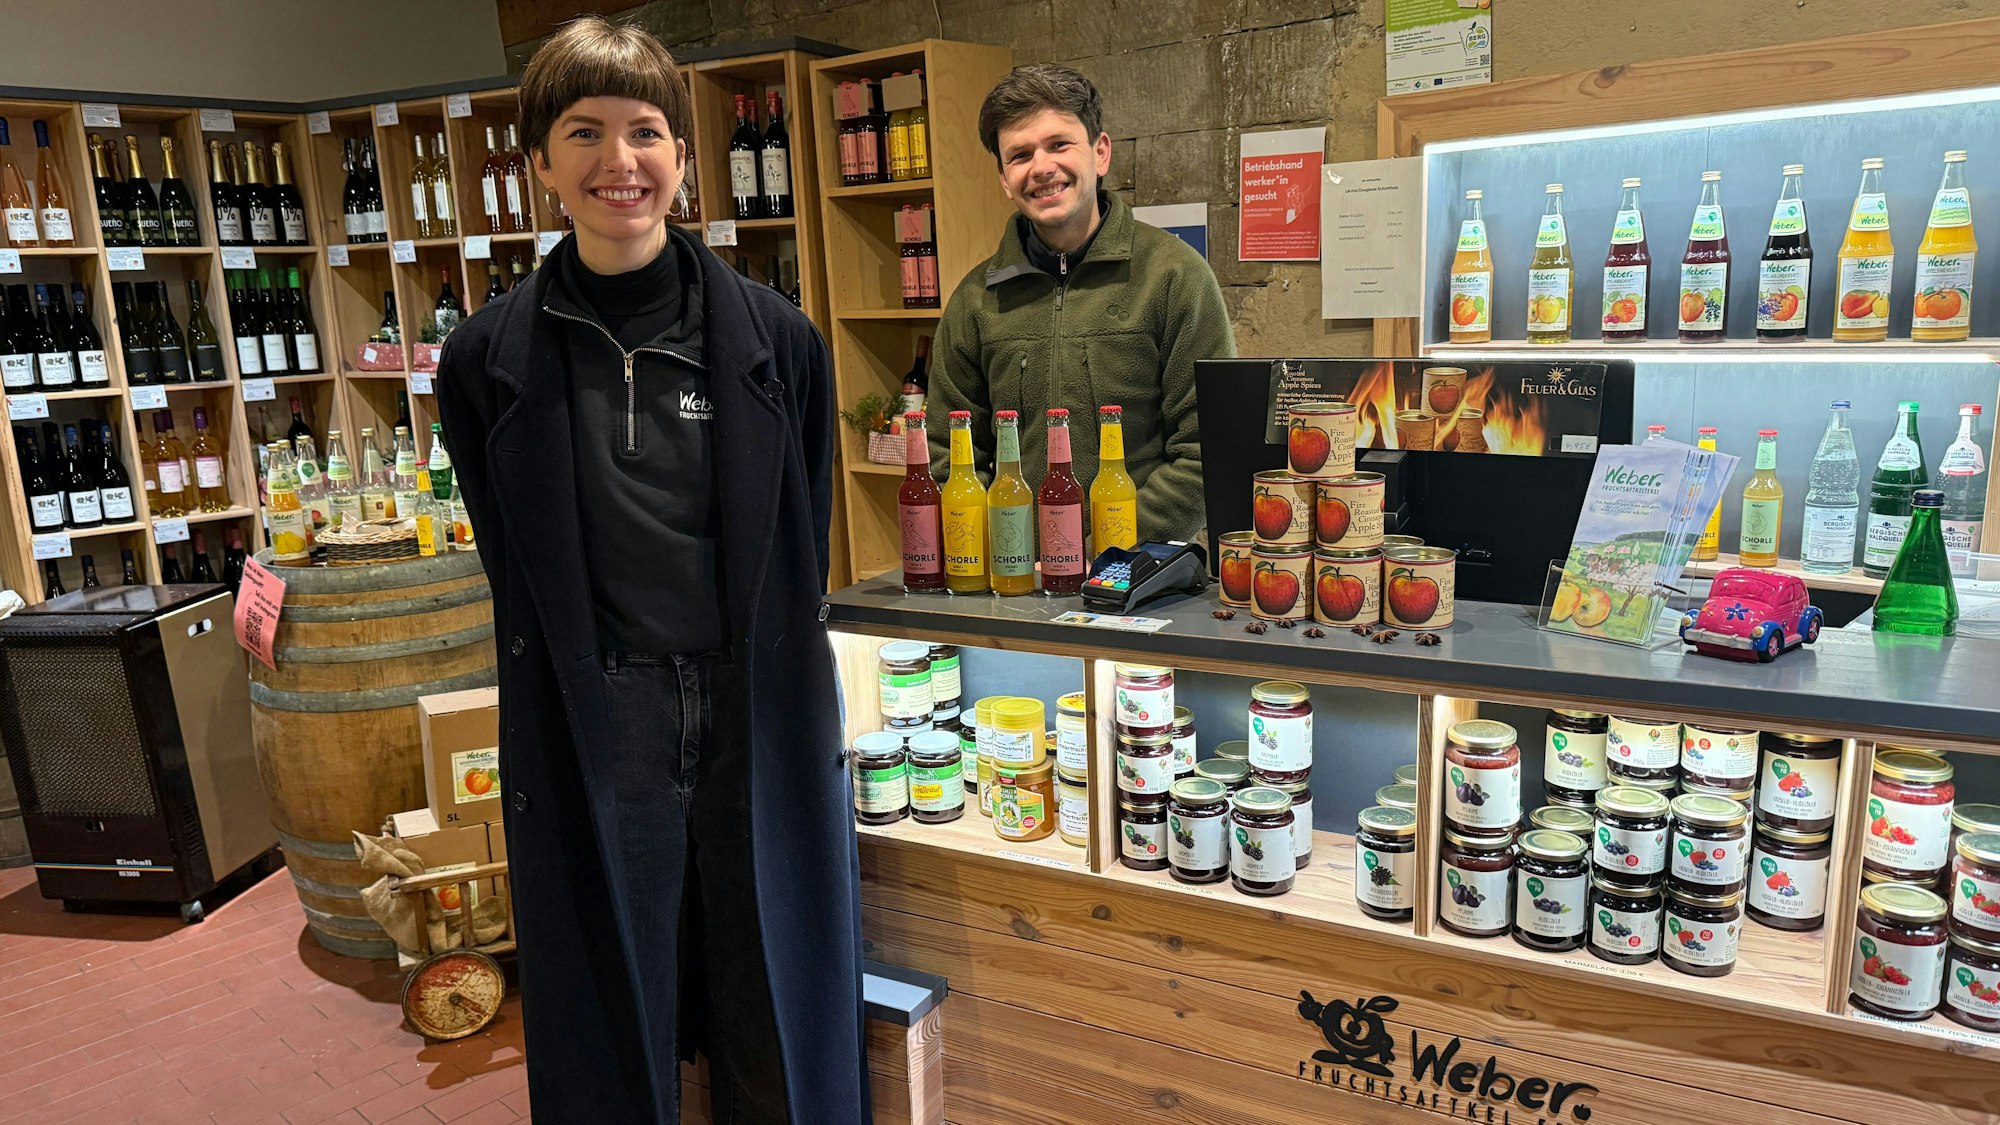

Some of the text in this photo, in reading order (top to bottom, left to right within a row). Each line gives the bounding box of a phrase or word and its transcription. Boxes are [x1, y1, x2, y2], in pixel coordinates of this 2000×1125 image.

[1245, 158, 1303, 172] Betriebshand
[1244, 190, 1277, 204] gesucht
[1278, 379, 1322, 390] Apple Spices
[1331, 429, 1345, 437] Fire
[1328, 450, 1352, 464] Apple
[1602, 484, 1660, 495] FRUCHTSAFTKELTEREI
[1354, 507, 1380, 516] Roasted
[1350, 521, 1375, 534] Apple
[994, 554, 1030, 563] SCHORLE
[1042, 554, 1079, 563] SCHORLE
[447, 813, 460, 822] 5L
[1564, 959, 1618, 973] MARMELADE
